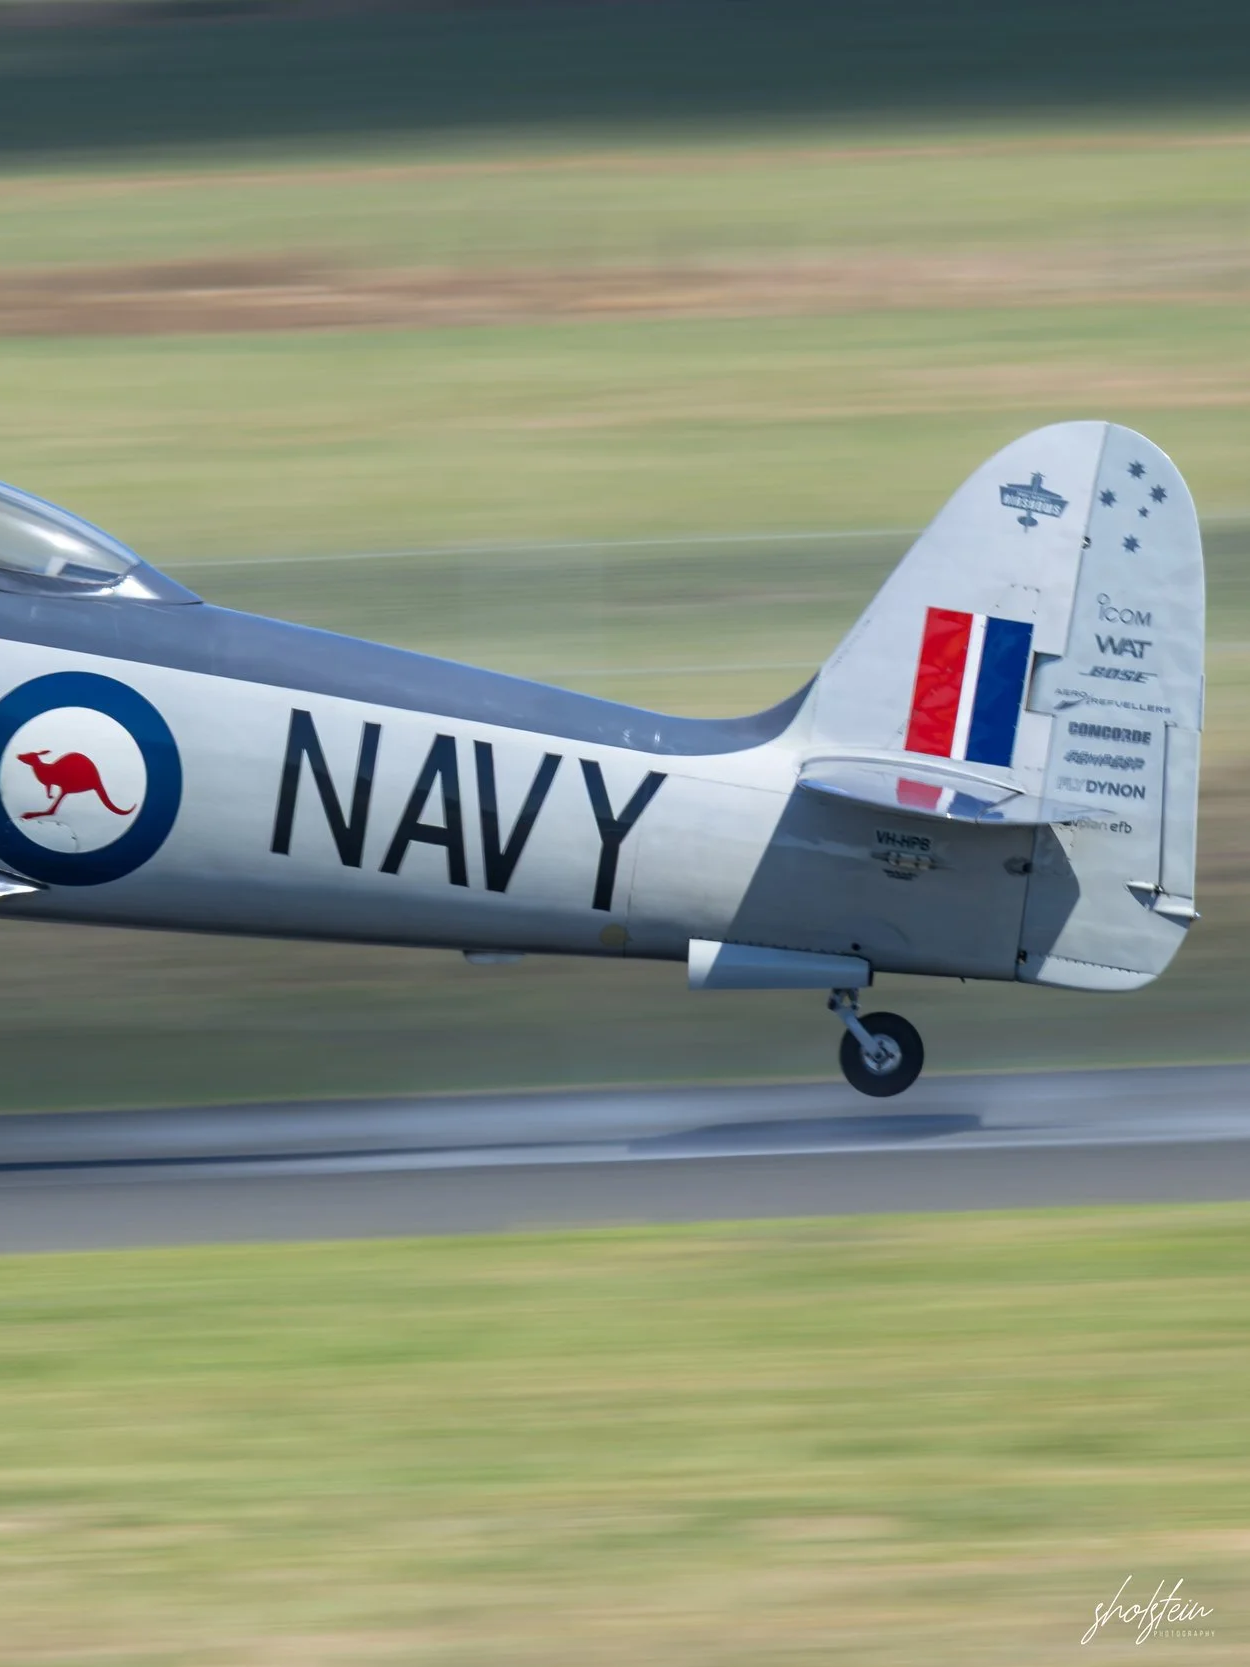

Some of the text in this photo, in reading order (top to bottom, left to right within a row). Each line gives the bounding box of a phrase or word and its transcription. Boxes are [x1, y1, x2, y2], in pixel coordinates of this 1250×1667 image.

[1094, 633, 1153, 659] WAT
[1080, 665, 1157, 684] BOSE
[1068, 721, 1152, 745] CONCORDE
[270, 707, 669, 913] NAVY
[1110, 821, 1133, 834] efb
